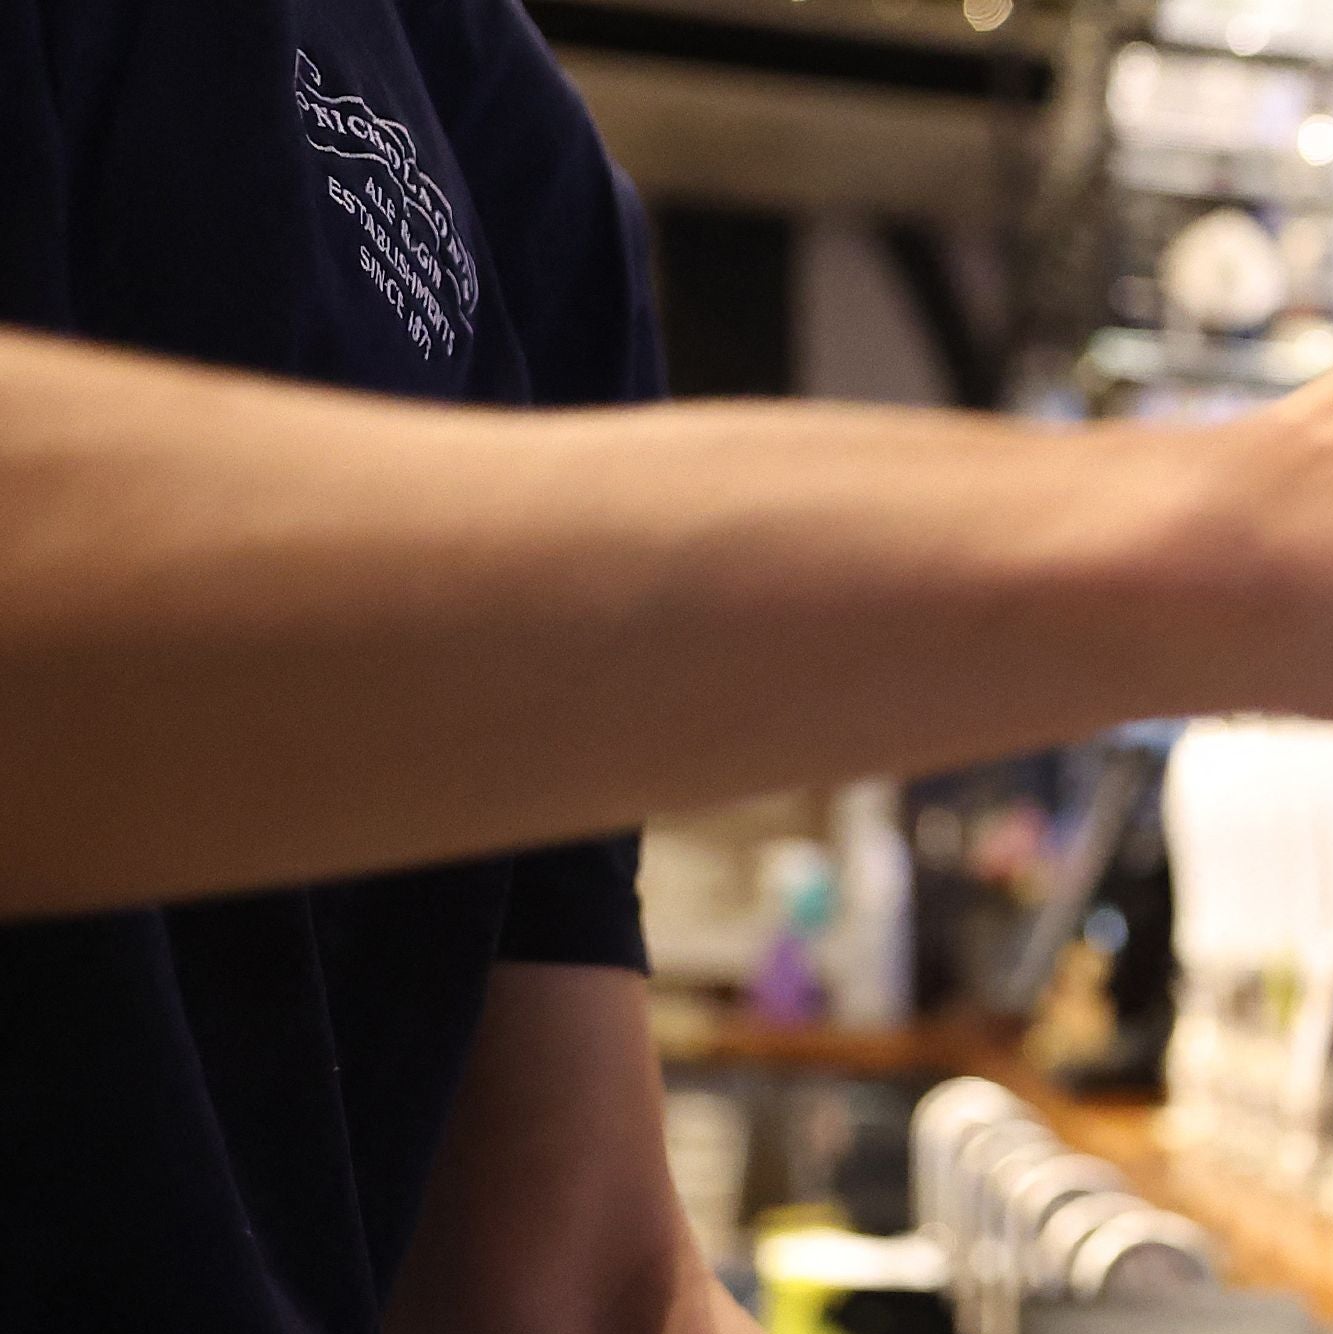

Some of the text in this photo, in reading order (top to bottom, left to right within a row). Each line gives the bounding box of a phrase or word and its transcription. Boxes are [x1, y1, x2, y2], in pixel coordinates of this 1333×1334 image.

[327, 175, 456, 357] ESTABLISHMENTS
[359, 244, 405, 319] SINCE
[364, 176, 396, 224] ALE
[415, 241, 442, 290] GIN
